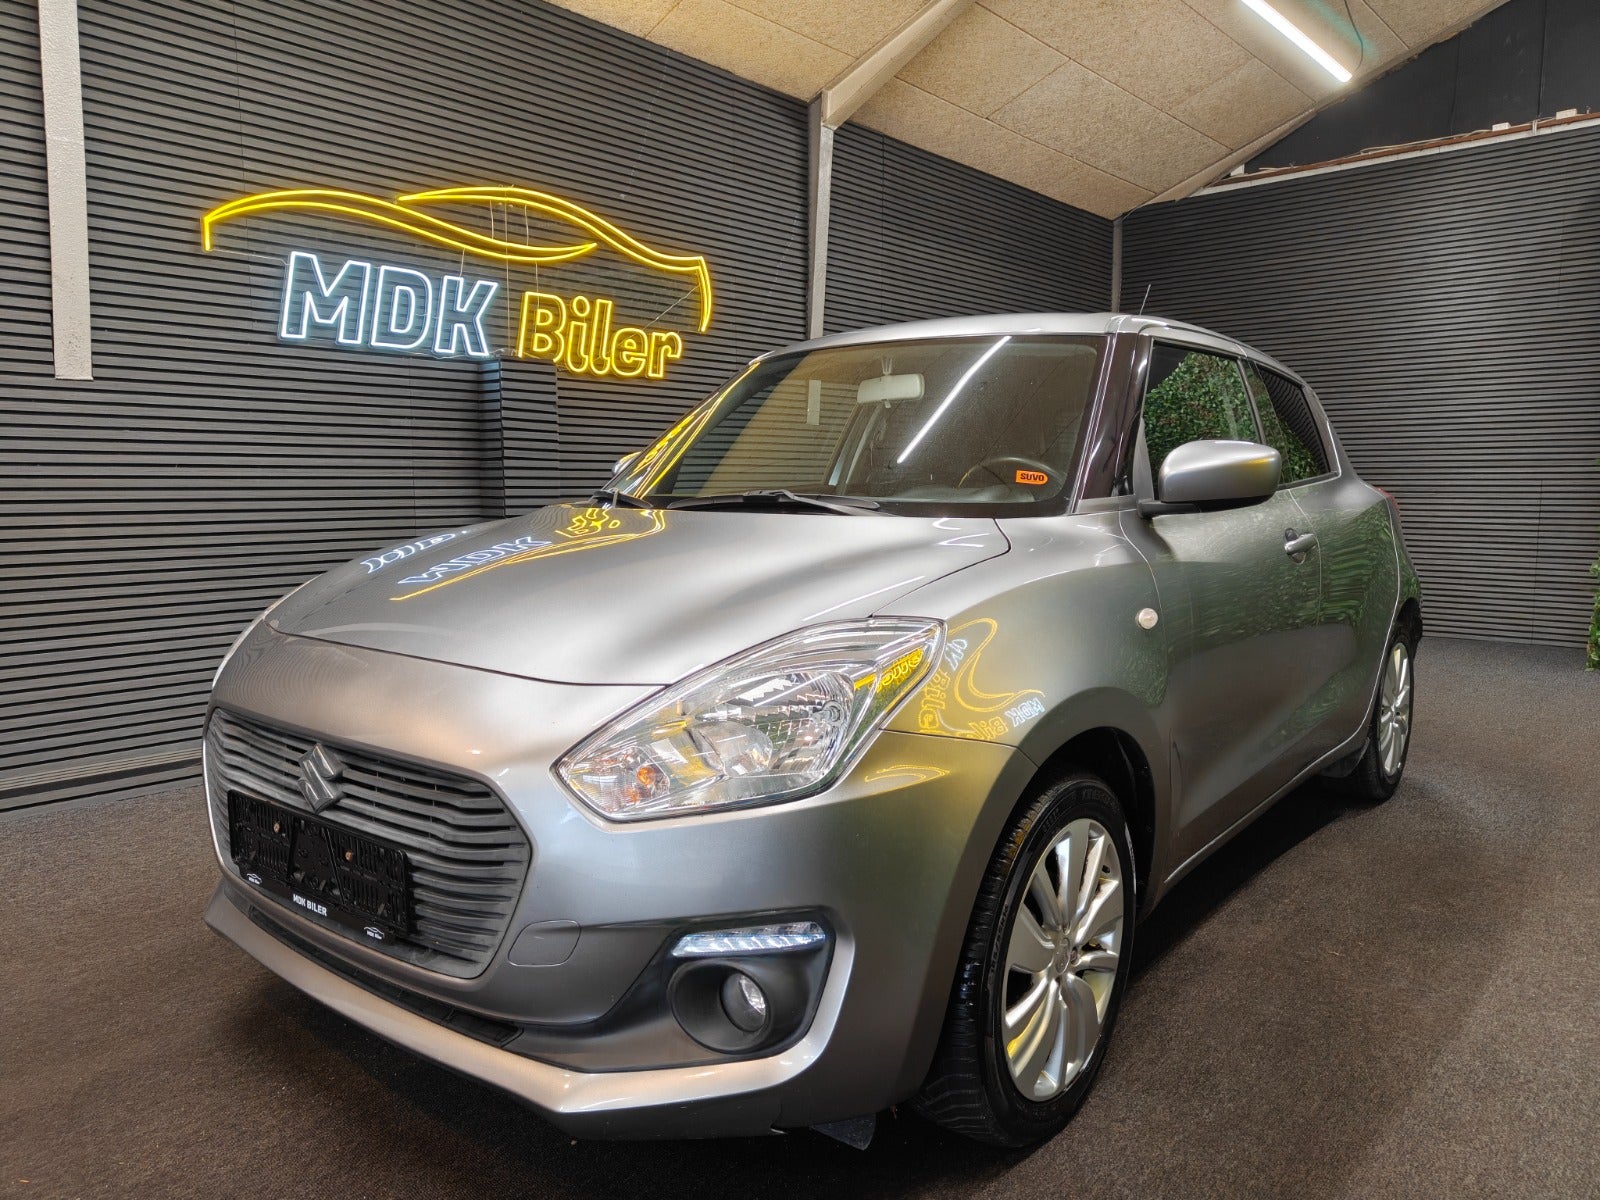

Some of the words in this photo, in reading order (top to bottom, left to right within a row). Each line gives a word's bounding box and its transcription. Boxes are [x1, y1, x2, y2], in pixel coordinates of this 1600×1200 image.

[280, 250, 498, 357] MDK
[517, 291, 683, 379] Biler
[1020, 472, 1045, 482] SUVO
[306, 899, 328, 917] BILER
